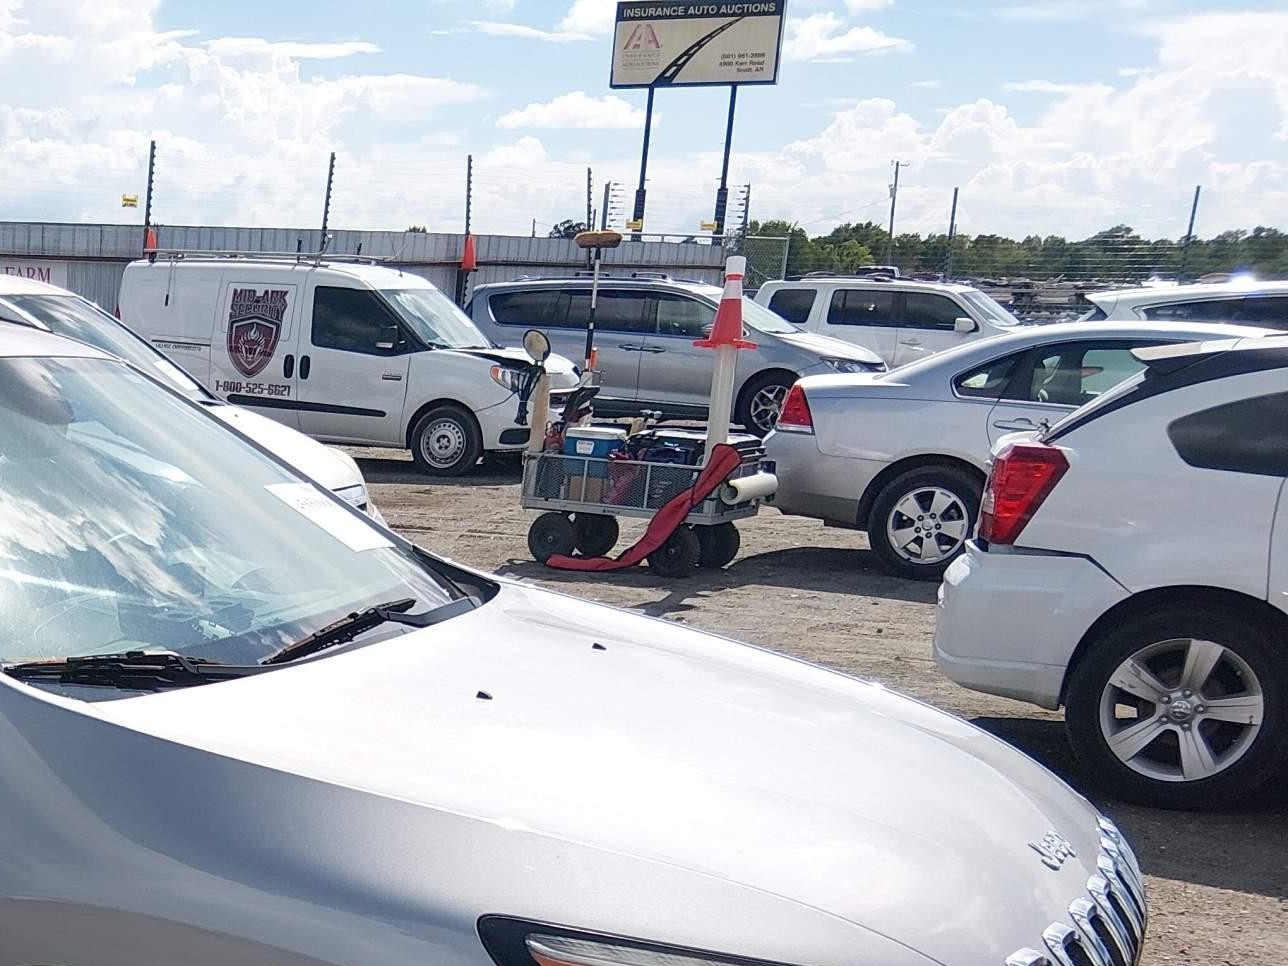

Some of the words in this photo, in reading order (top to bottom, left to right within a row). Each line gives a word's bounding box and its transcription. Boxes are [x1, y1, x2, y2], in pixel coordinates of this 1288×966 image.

[623, 6, 686, 18] INSURANCE
[687, 5, 718, 15] AUTO
[719, 2, 776, 14] AUCTIONS
[231, 288, 289, 304] MID-ARK
[231, 303, 288, 320] SECURITY
[215, 380, 291, 397] 1-800-525-6621
